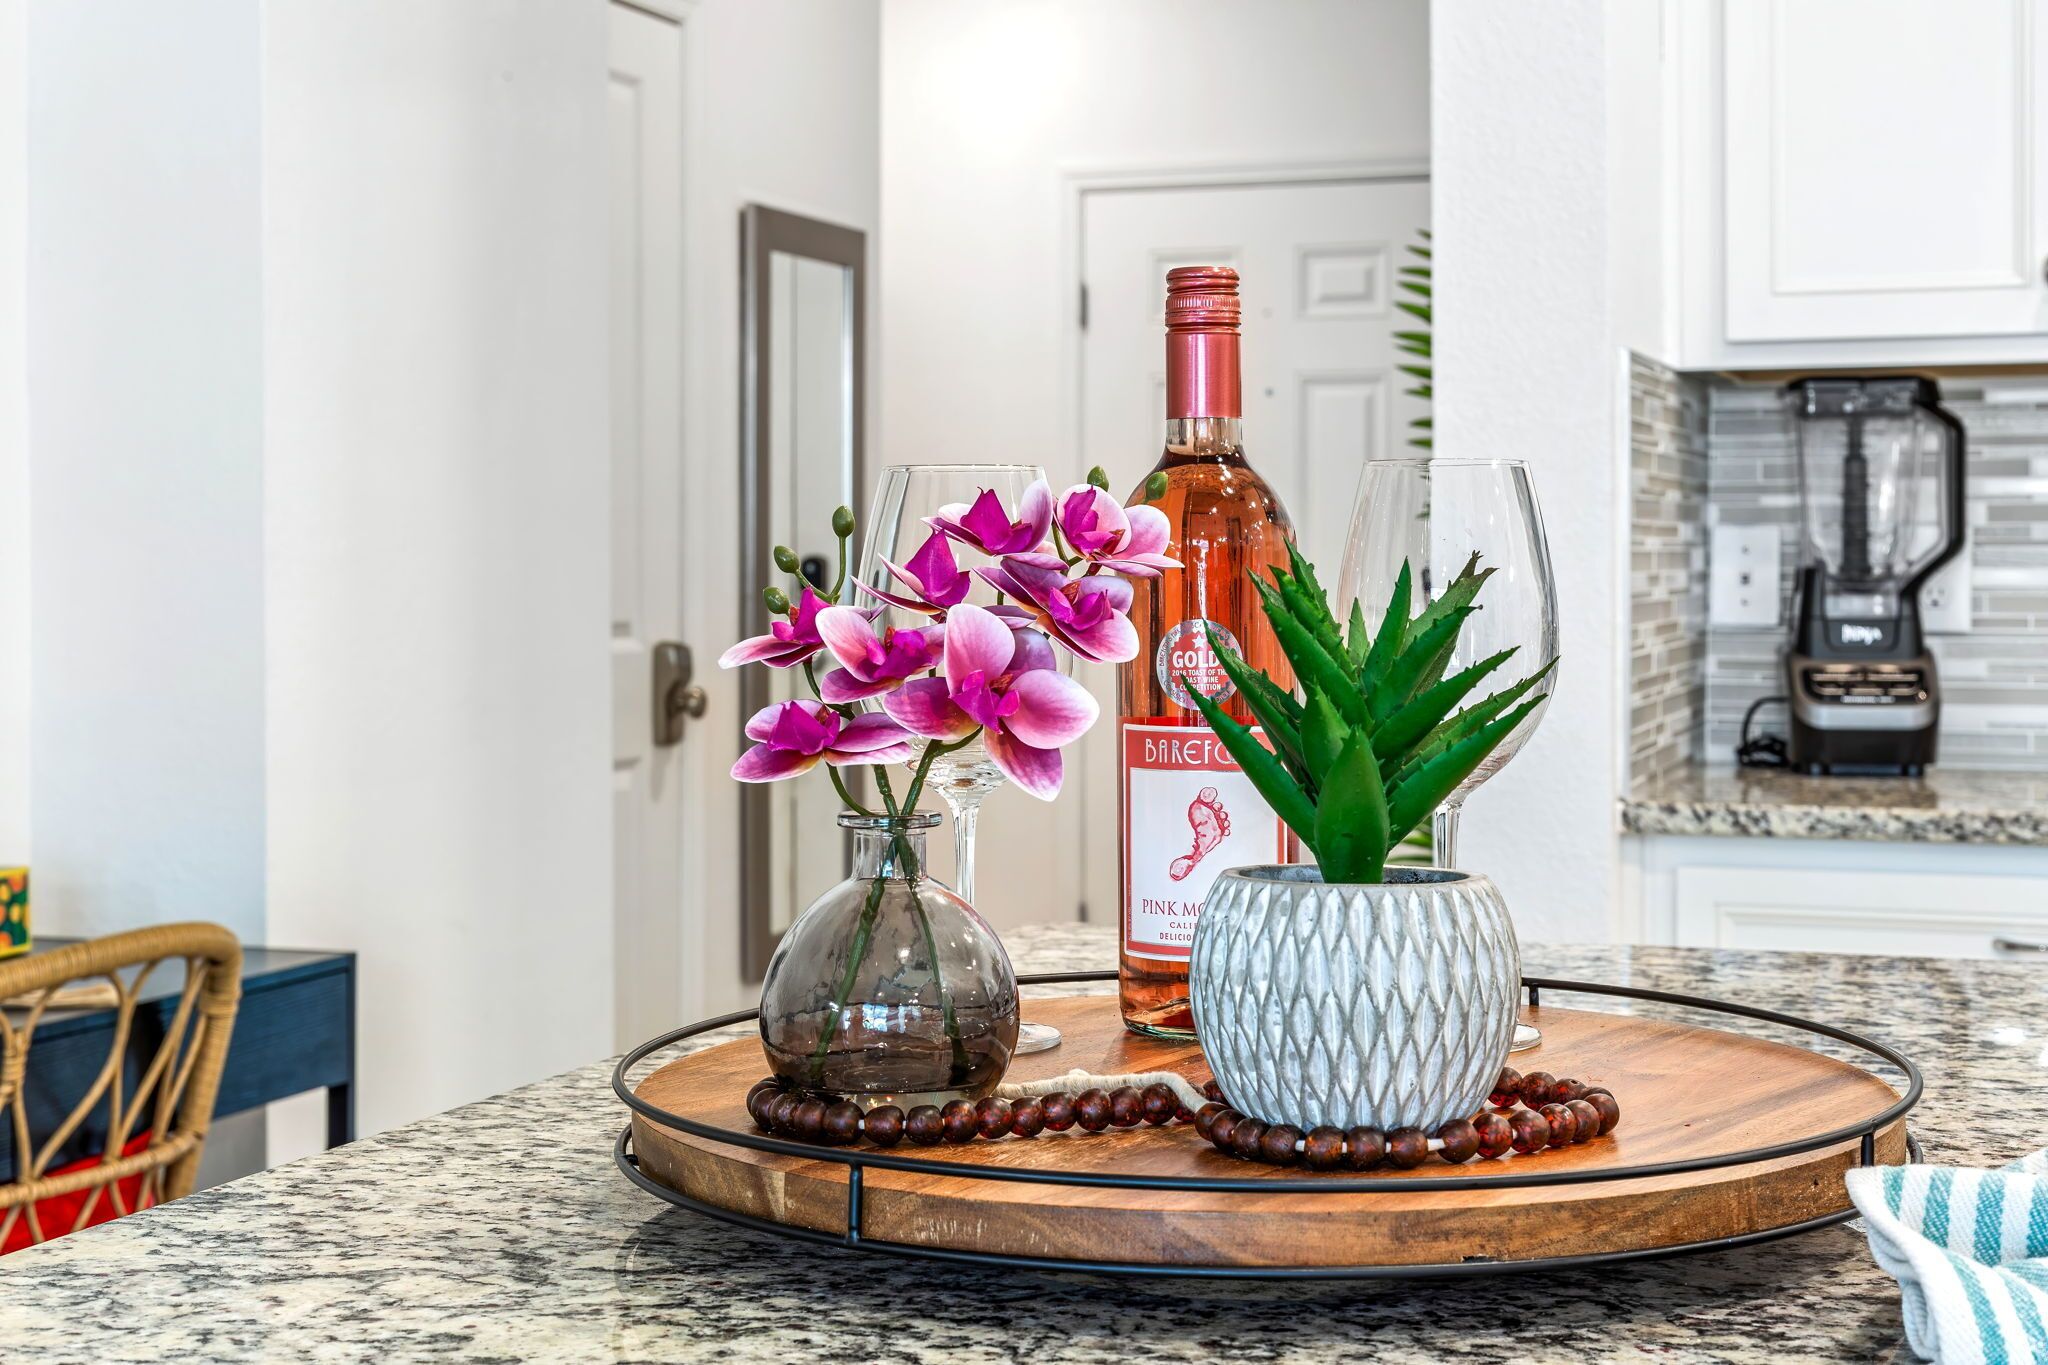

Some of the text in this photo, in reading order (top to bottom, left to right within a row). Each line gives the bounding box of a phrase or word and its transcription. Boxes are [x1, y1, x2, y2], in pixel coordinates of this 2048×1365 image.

[1172, 650, 1220, 668] GOLD
[1145, 738, 1238, 765] BAREFO
[1142, 898, 1178, 916] PINK
